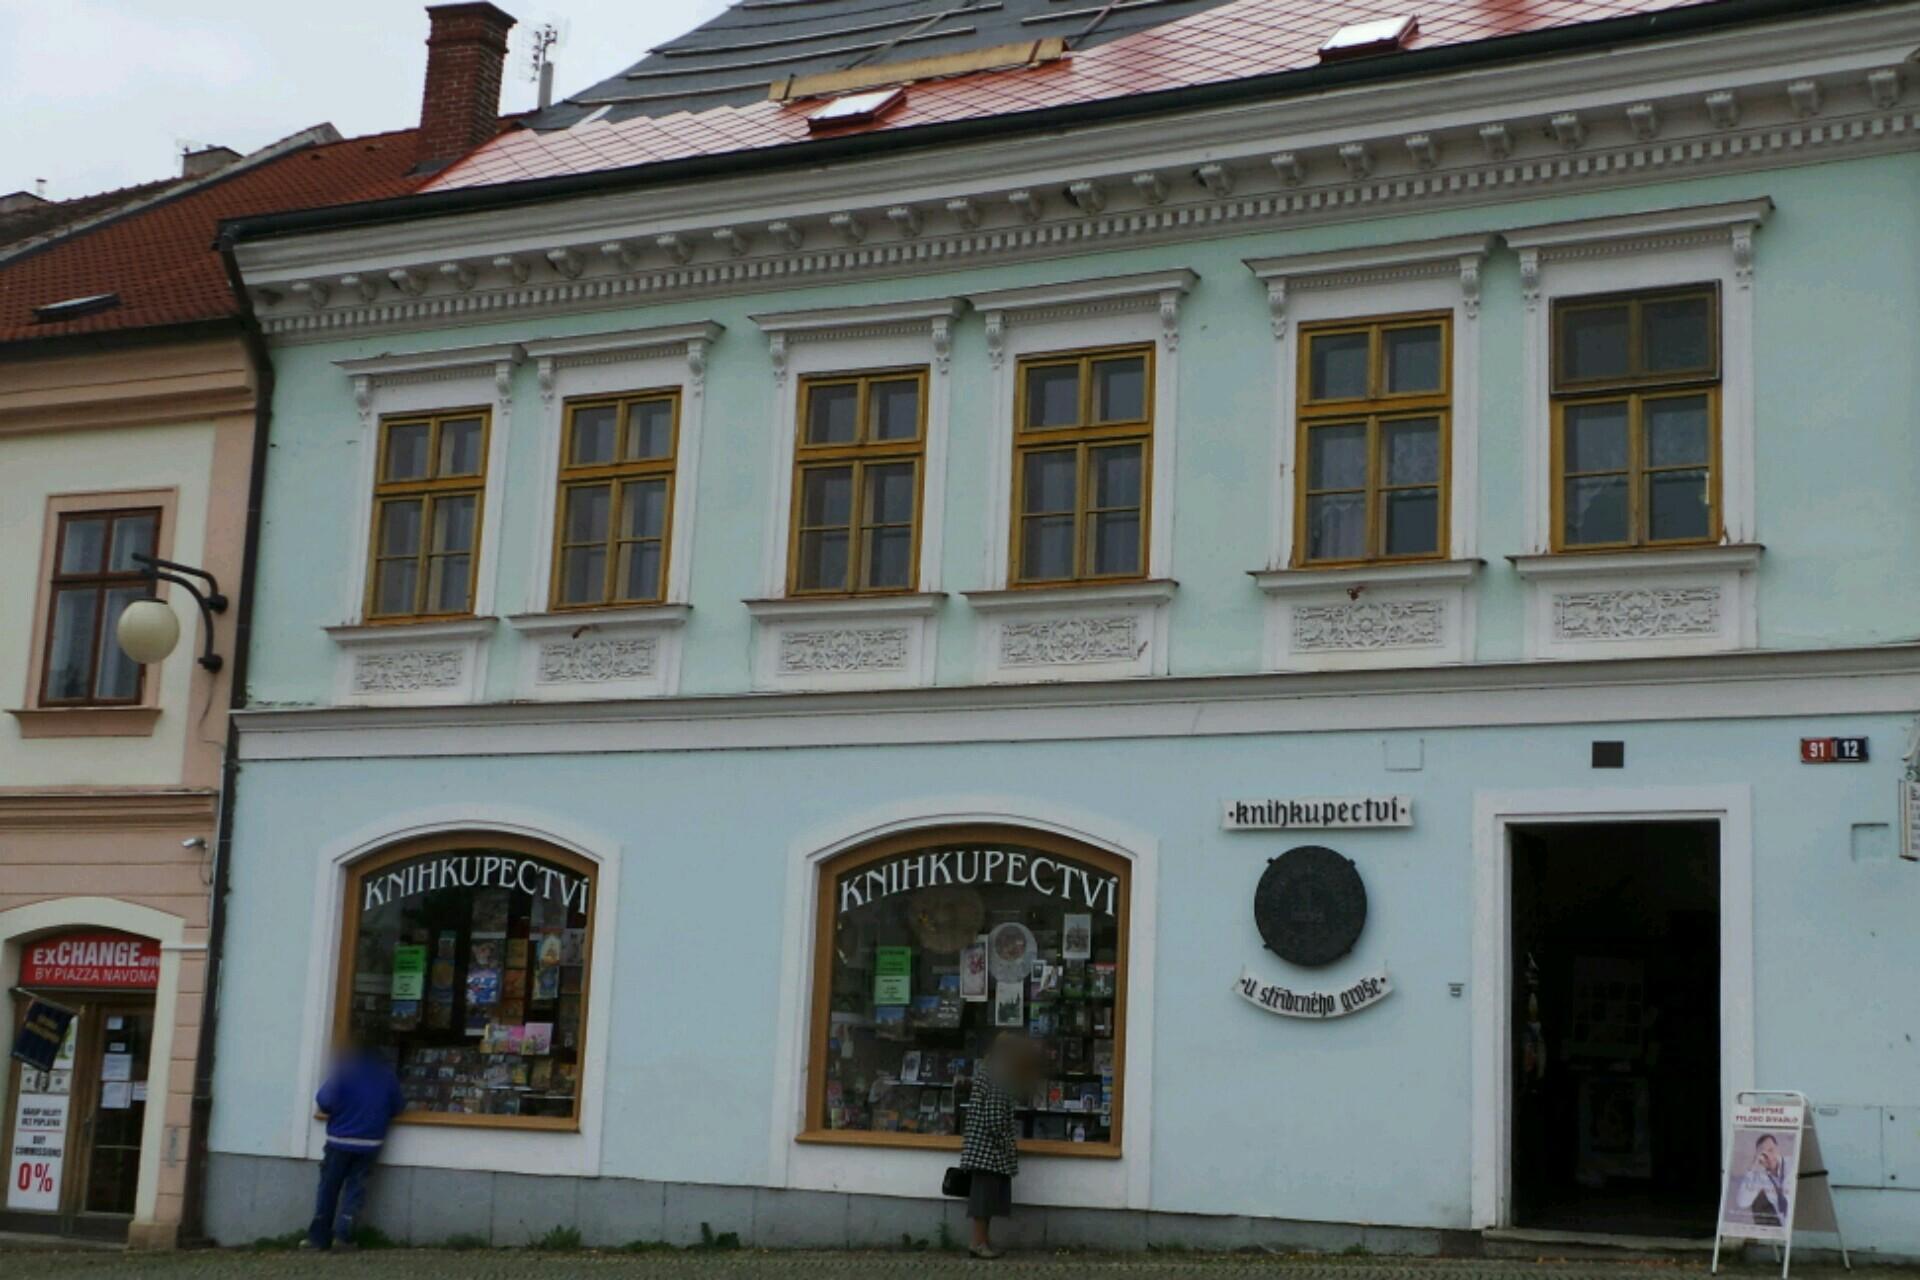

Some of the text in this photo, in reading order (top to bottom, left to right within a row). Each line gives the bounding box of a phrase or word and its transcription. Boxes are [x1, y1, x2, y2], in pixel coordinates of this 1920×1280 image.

[1808, 740, 1859, 758] 91 12
[1236, 796, 1398, 827] knihkupectví
[363, 856, 590, 914] KNIHKUPECTVÍ
[840, 850, 1119, 916] KNIHKUPECTVÍ
[35, 967, 156, 983] BY PIAZZA NAVONA
